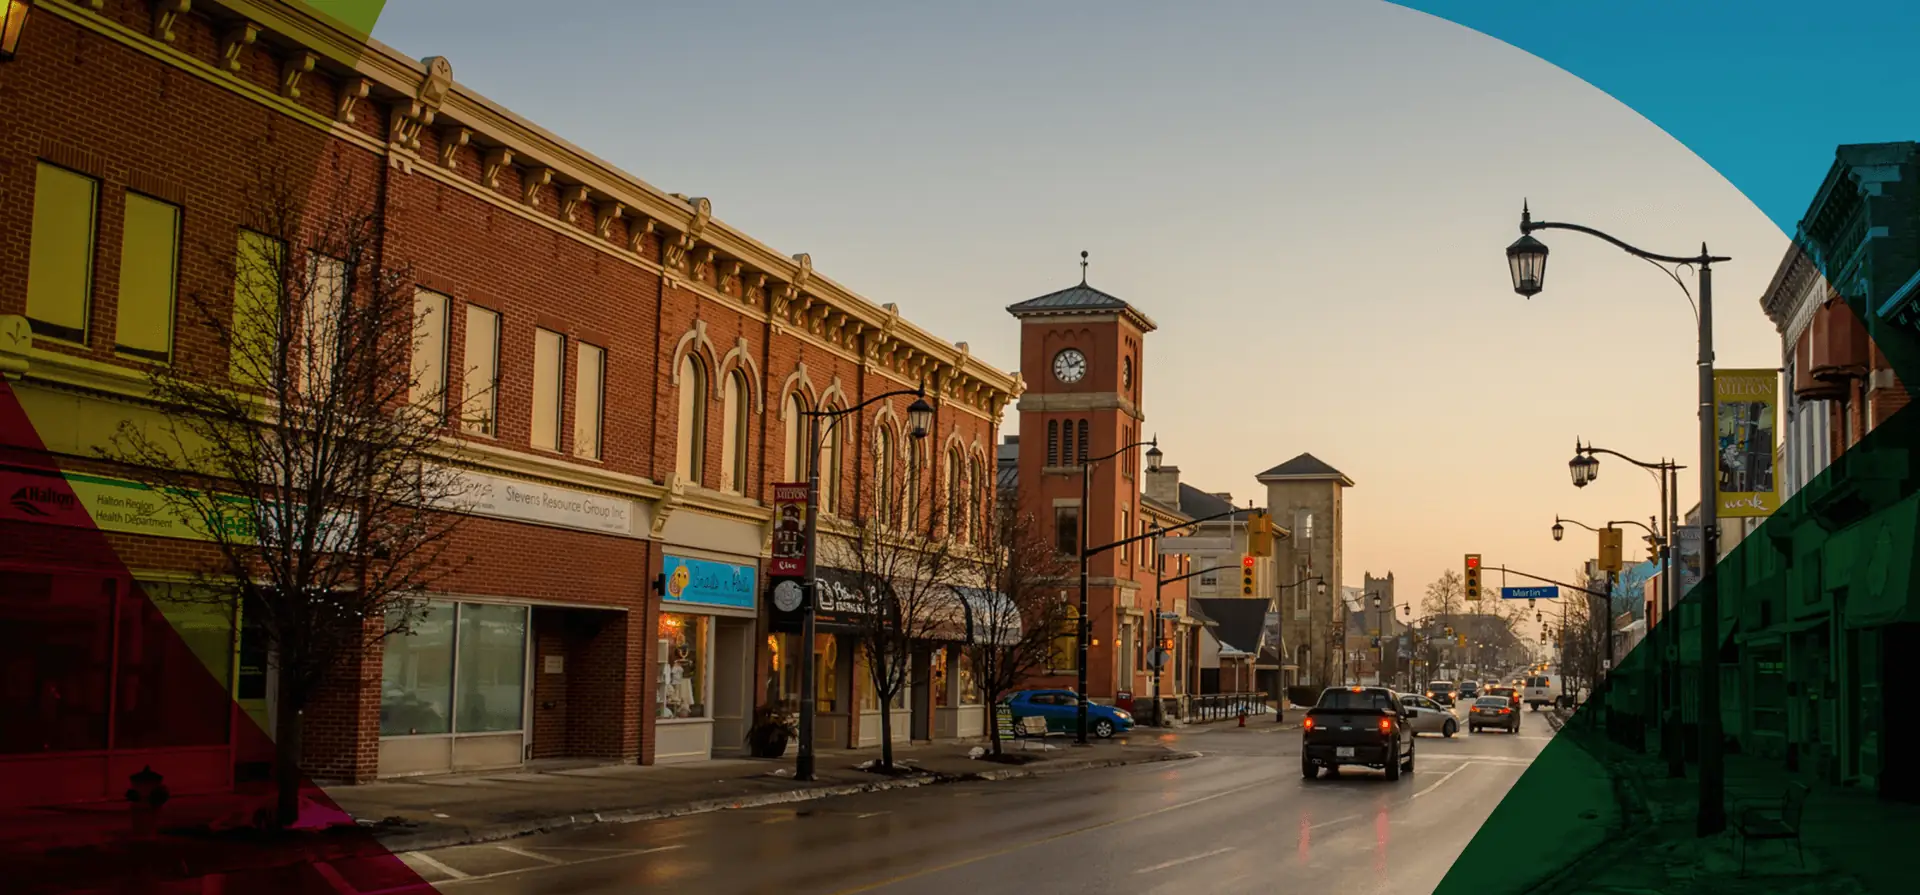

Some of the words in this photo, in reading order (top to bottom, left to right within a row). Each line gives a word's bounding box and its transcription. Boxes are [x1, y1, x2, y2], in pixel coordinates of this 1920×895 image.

[1718, 383, 1772, 395] MILTON
[29, 487, 74, 505] Halton
[96, 494, 124, 508] Halton
[125, 498, 155, 512] Region
[505, 485, 541, 506] Stevens
[542, 493, 581, 513] Resource
[583, 500, 611, 520] Group
[776, 491, 808, 500] MILTON
[1724, 493, 1770, 511] work
[95, 509, 123, 523] Health
[124, 513, 173, 529] Department
[1512, 589, 1541, 597] Martin
